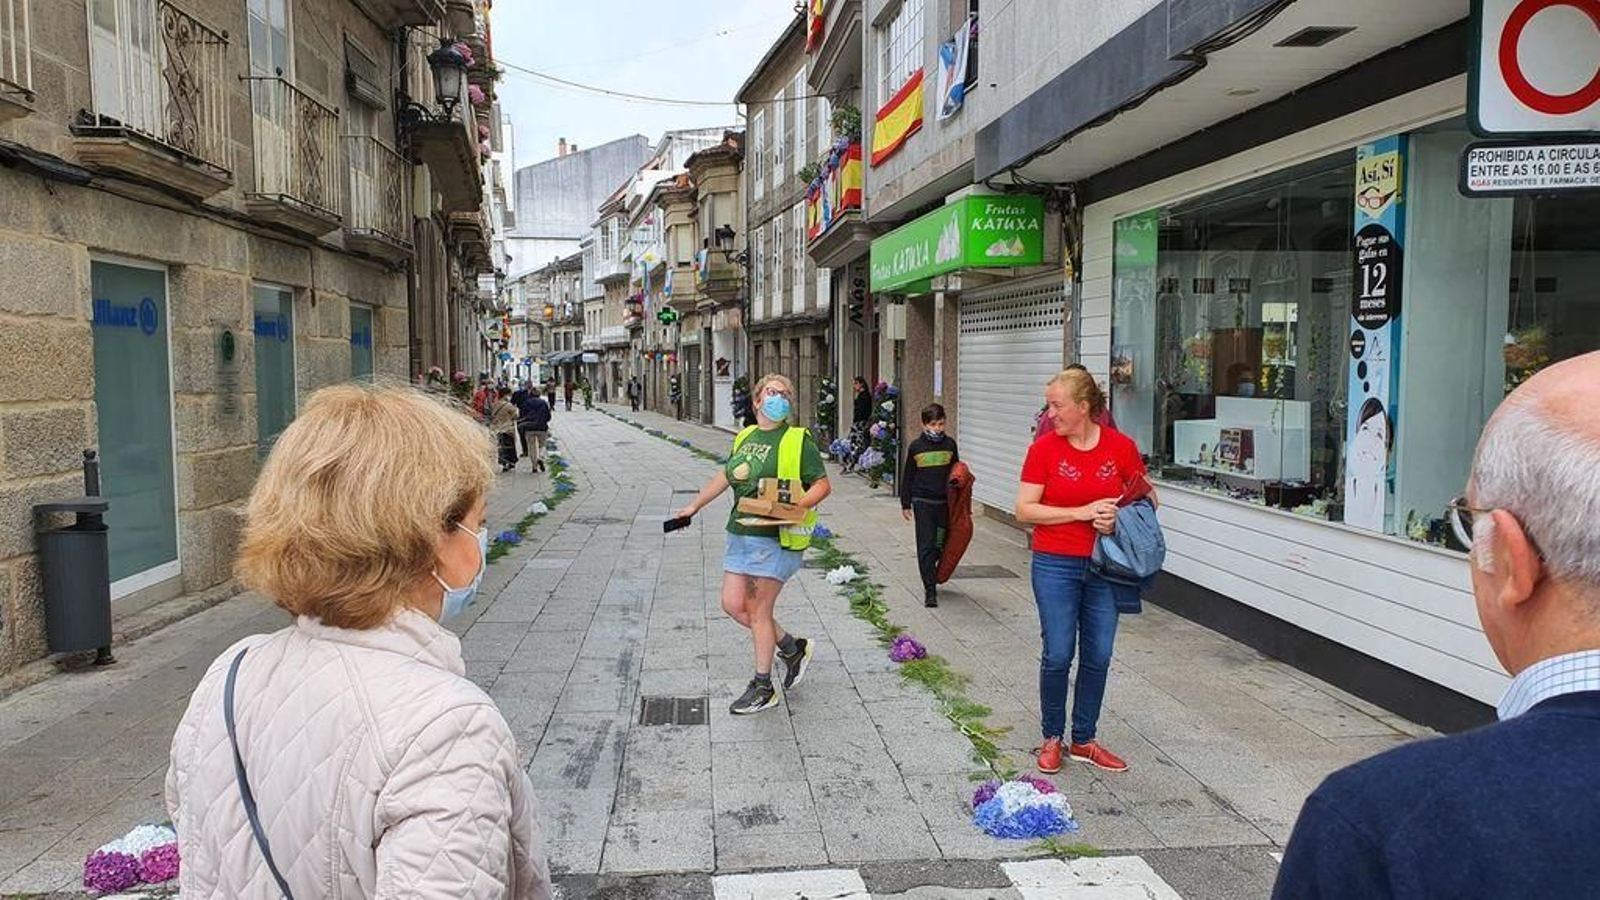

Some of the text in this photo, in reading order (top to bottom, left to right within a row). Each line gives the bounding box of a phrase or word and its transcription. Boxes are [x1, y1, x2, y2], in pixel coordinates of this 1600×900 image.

[1470, 149, 1534, 162] PROHIBIDA
[1537, 150, 1546, 161] A
[1382, 158, 1395, 179] Sí
[1471, 164, 1509, 176] ENTRE
[1512, 164, 1529, 176] AS
[1533, 163, 1560, 175] 16.00
[1564, 163, 1571, 174] E
[1574, 162, 1590, 174] AS
[985, 204, 1025, 214] Frutas
[972, 218, 1039, 230] KATUXA
[892, 239, 929, 277] KATUXA
[1360, 262, 1387, 298] 12
[1360, 299, 1386, 309] meses
